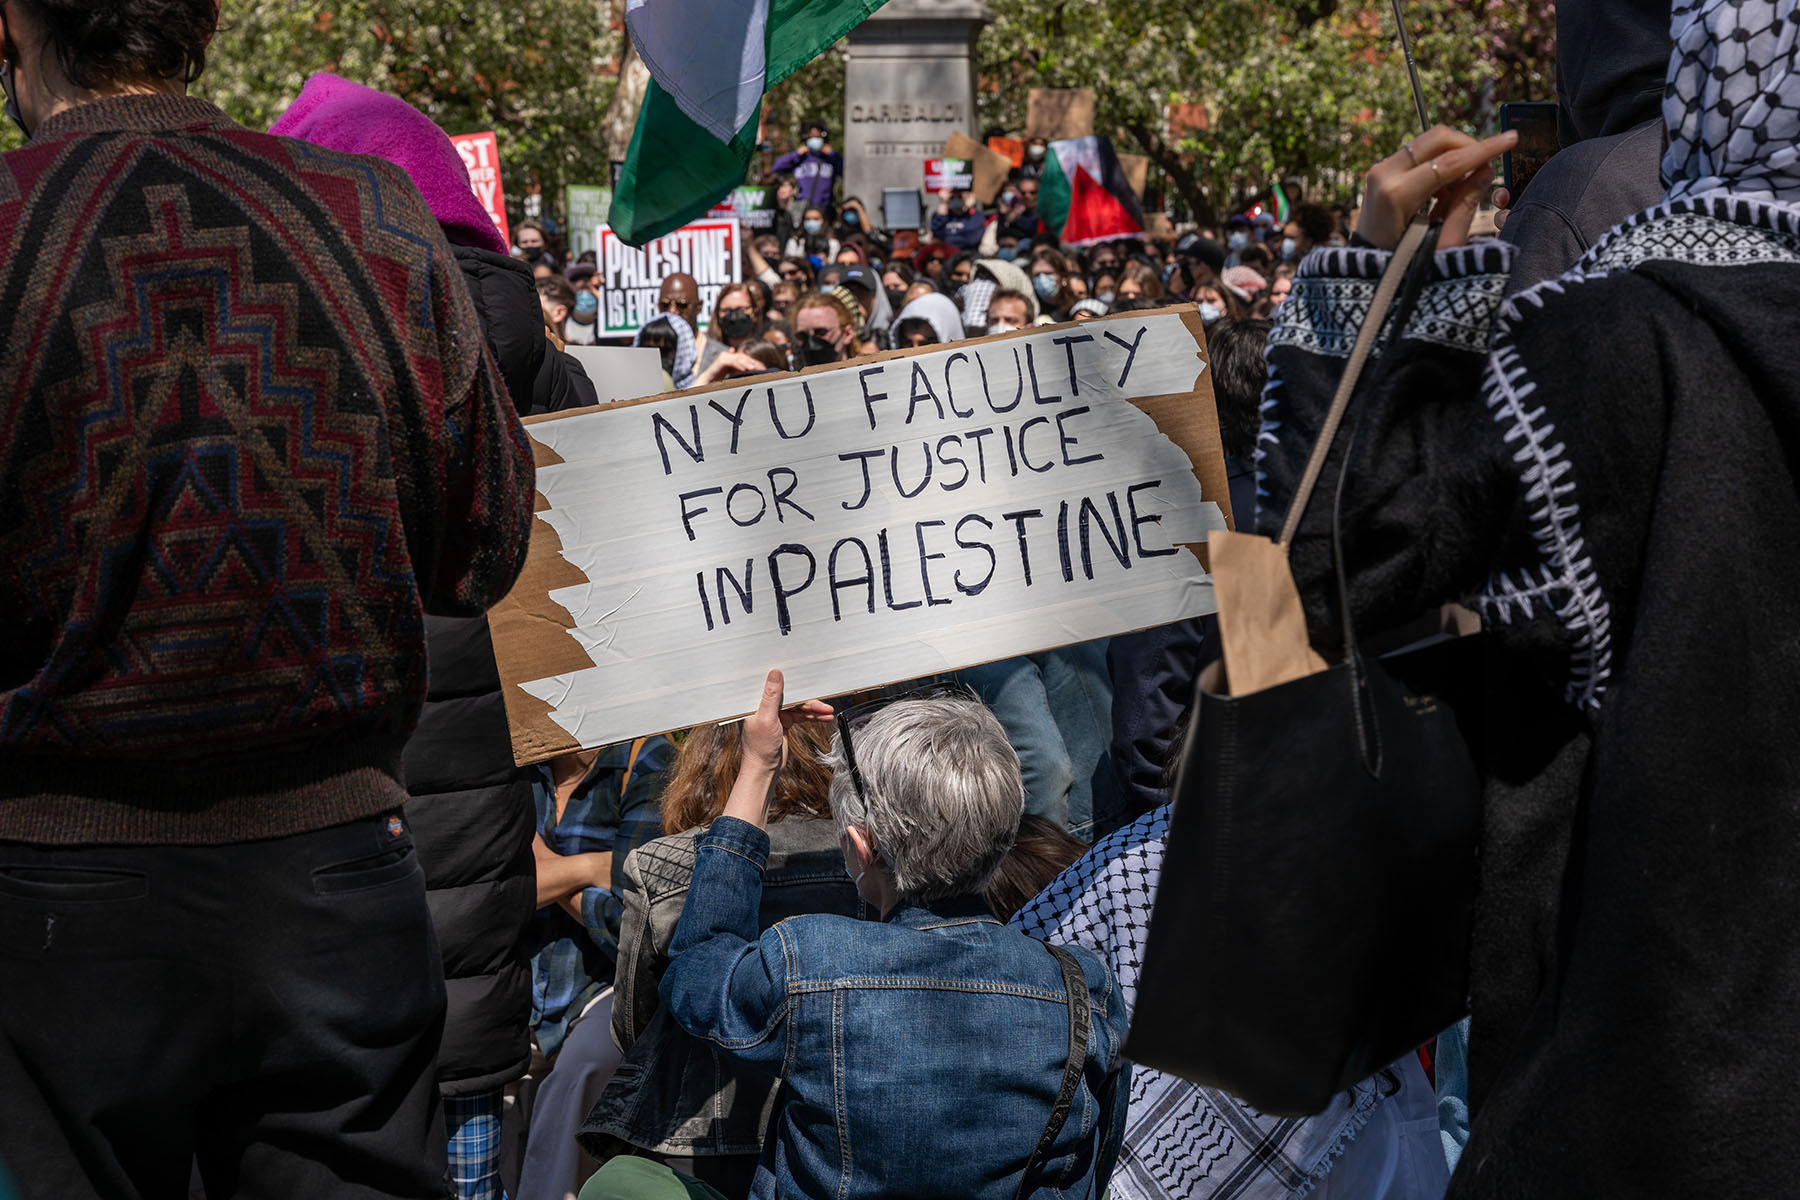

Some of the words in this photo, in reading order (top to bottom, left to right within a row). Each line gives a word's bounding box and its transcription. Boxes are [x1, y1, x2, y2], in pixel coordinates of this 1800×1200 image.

[605, 228, 732, 290] PALESTINE
[652, 381, 815, 475] NYU
[859, 326, 1147, 430] FACULTY
[679, 467, 815, 541] FOR
[838, 406, 1104, 510] JUSTICE
[697, 558, 753, 631] IN
[768, 480, 1179, 636] PALESTINE
